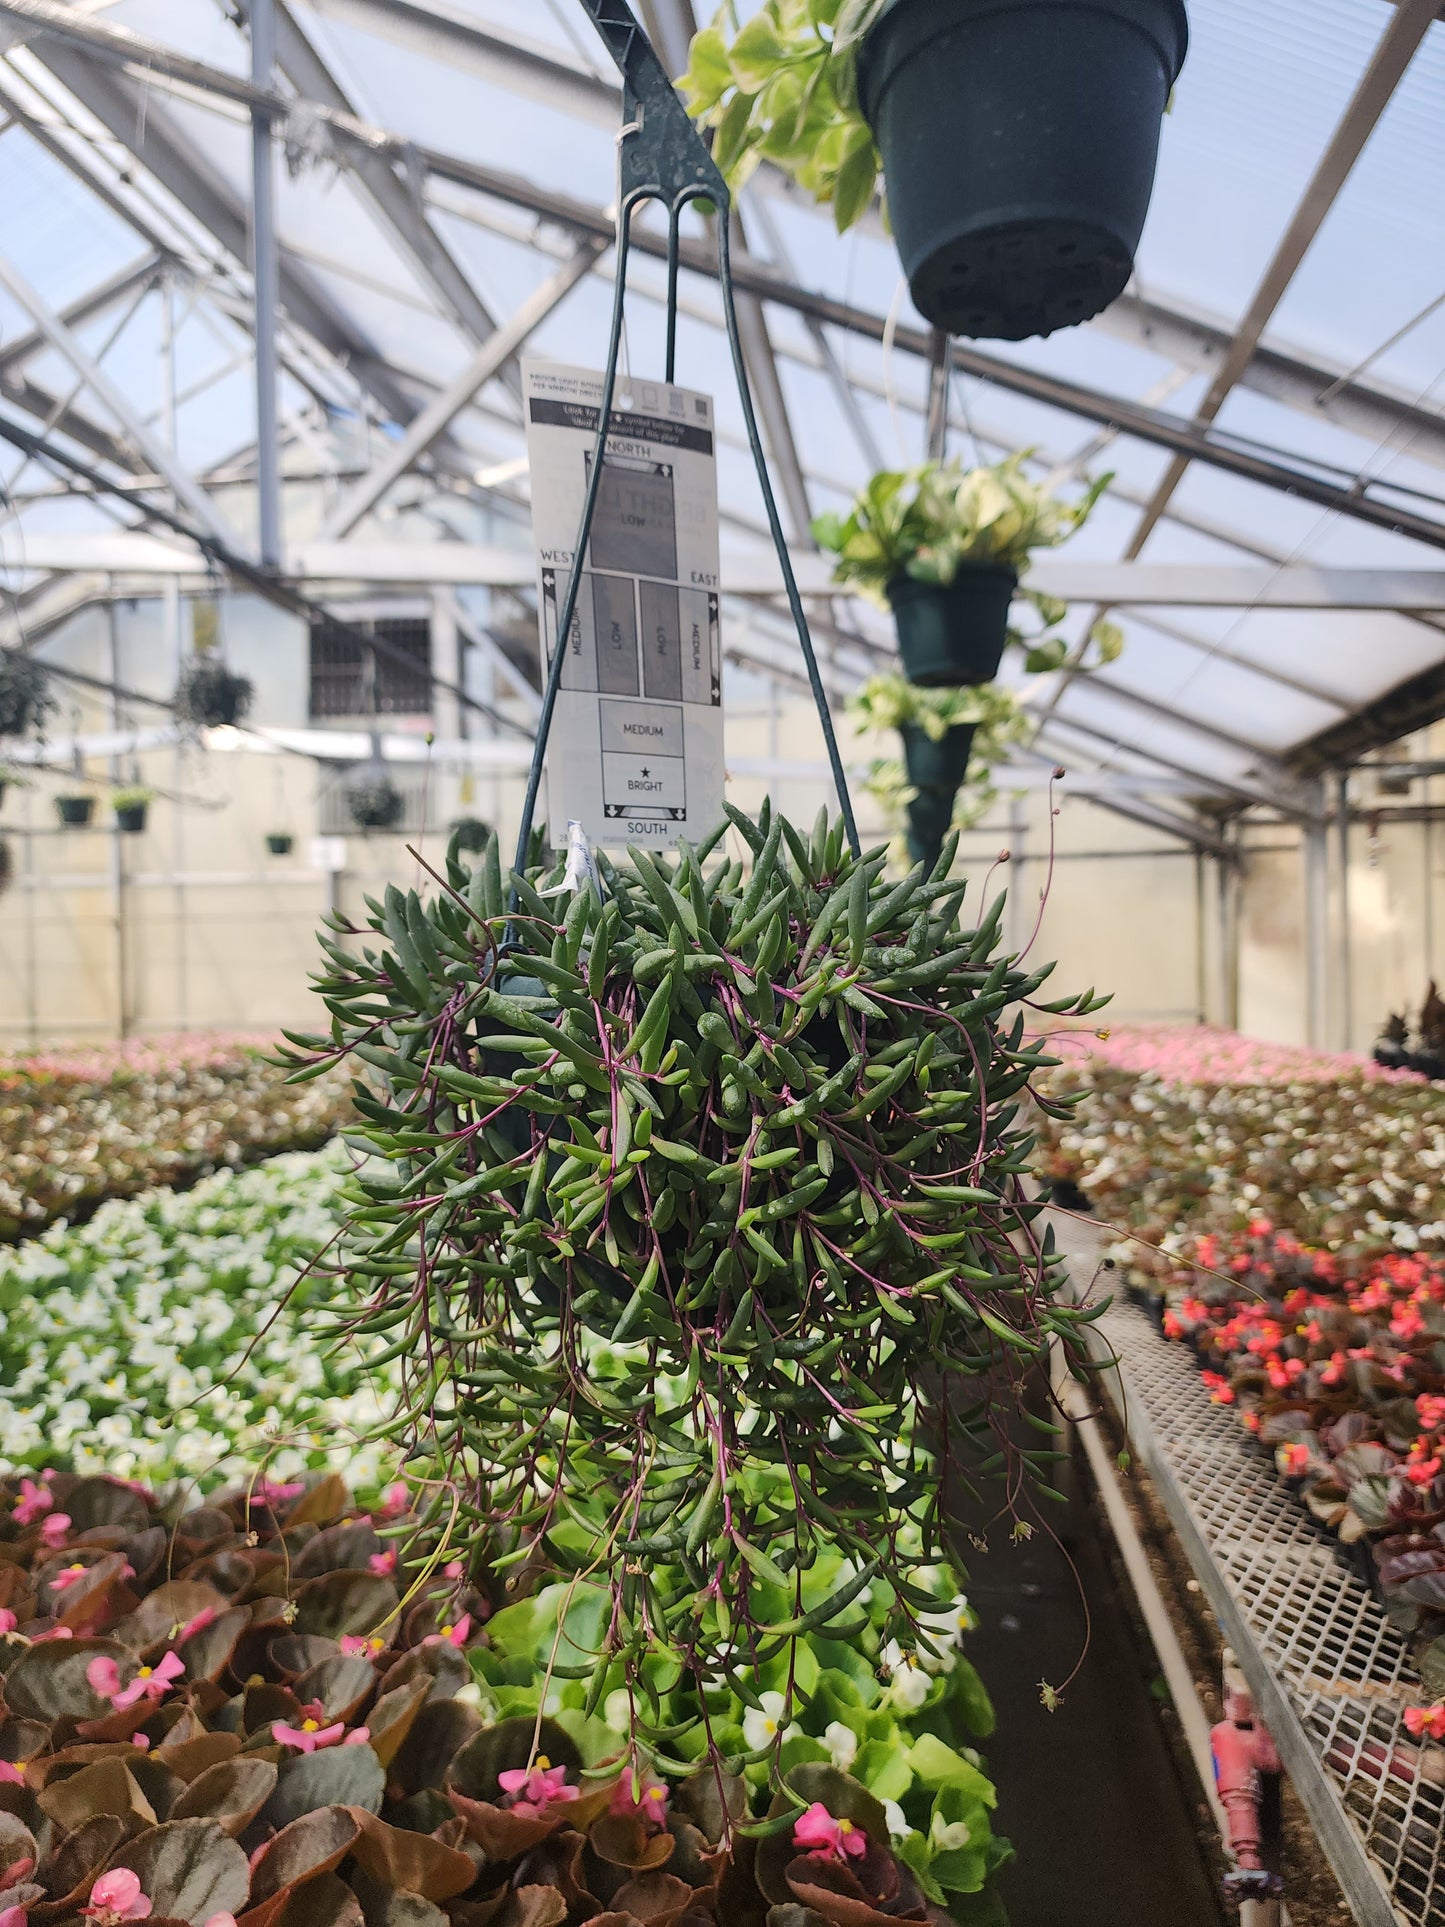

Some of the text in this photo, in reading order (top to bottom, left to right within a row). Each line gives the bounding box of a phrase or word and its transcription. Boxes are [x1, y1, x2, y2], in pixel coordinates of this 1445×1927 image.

[607, 441, 651, 458] NORTH
[621, 514, 646, 528] LOW
[540, 549, 576, 564] WEST
[691, 571, 718, 586] EAST
[572, 607, 582, 656] MEDIUM
[611, 621, 623, 650] LOW
[656, 627, 667, 656] LOW
[692, 623, 701, 670] MEDIUM
[623, 723, 664, 737] MEDIUM
[627, 780, 664, 792] BRIGHT
[627, 822, 668, 835] SOUTH
